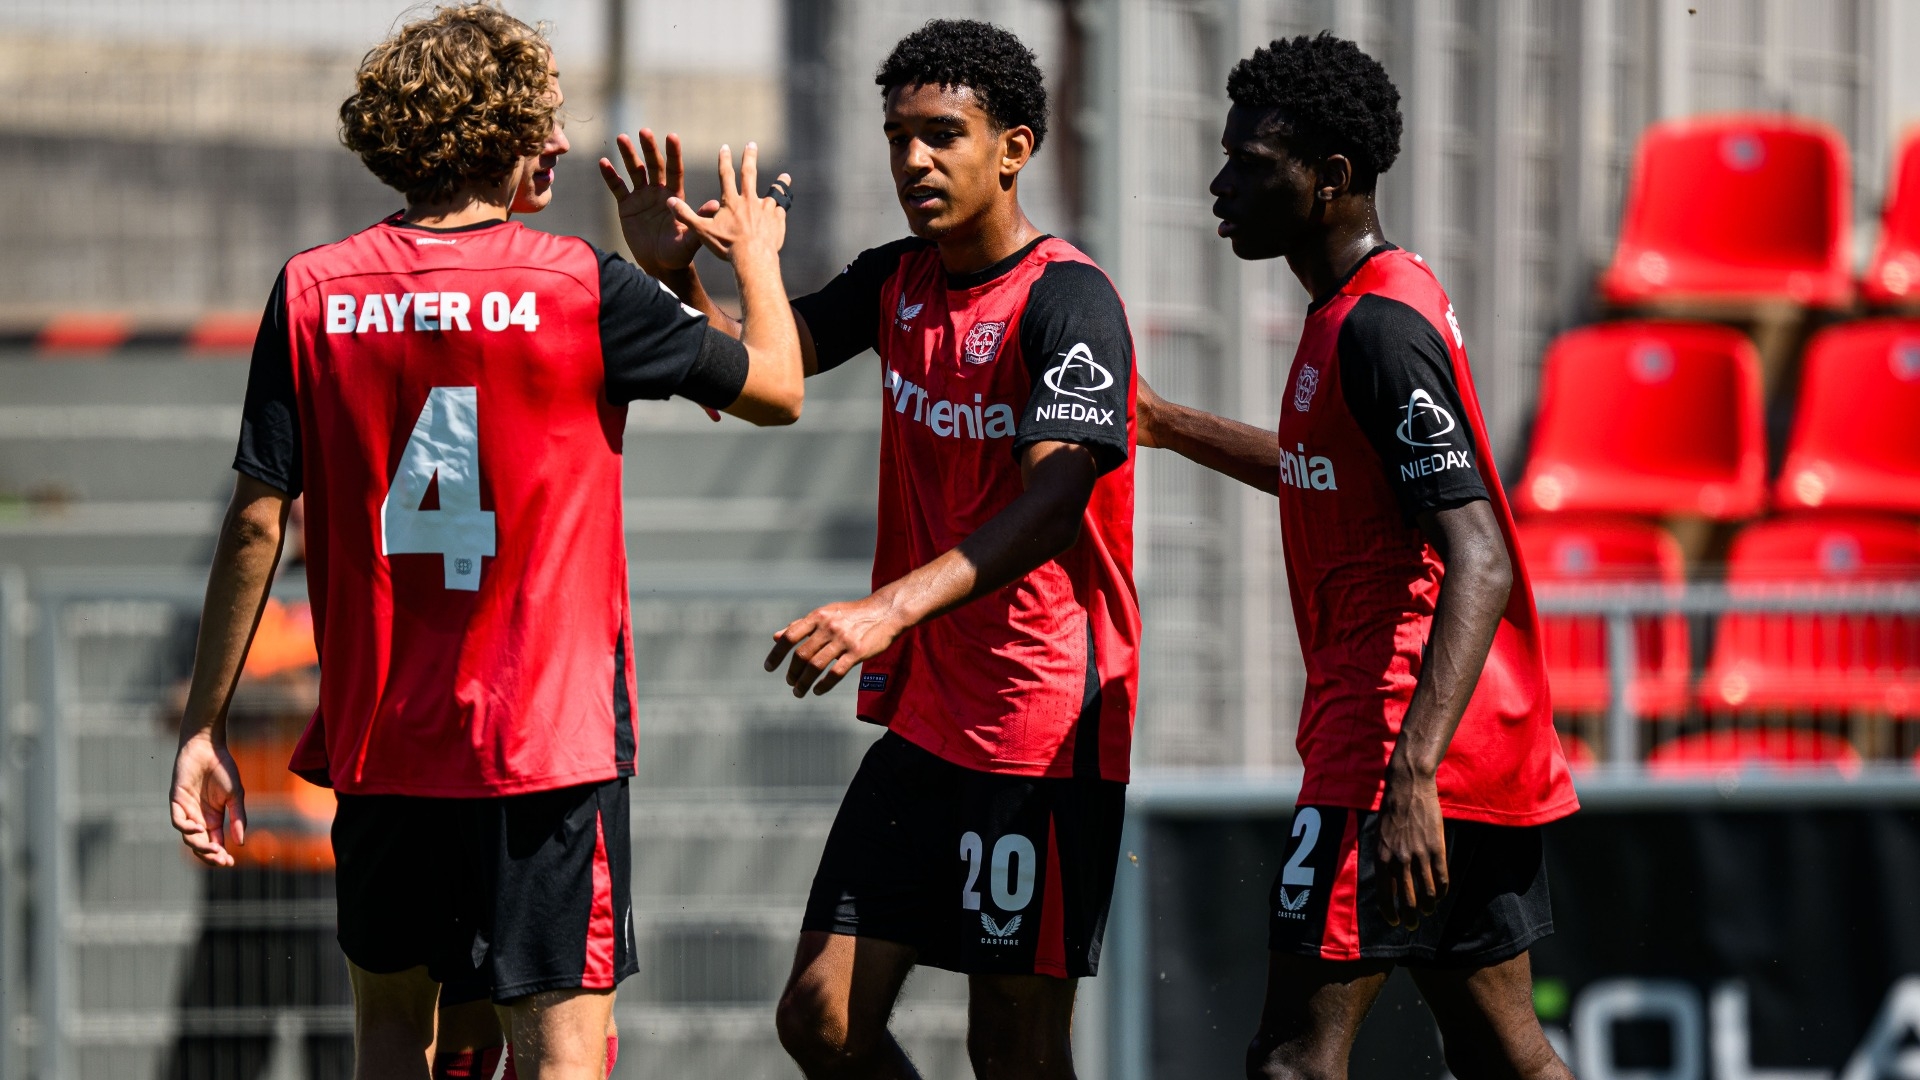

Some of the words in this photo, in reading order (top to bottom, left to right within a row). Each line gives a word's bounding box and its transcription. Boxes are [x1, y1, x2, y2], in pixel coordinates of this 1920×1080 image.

[326, 291, 472, 334] BAYER
[481, 291, 540, 333] 04
[1036, 403, 1115, 426] NIEDAX
[1400, 450, 1472, 482] NIEDAX
[381, 387, 496, 591] 4
[1282, 807, 1322, 886] 2
[960, 831, 1036, 911] 20
[1278, 910, 1306, 920] CASTORE
[981, 937, 1019, 946] CASTORE
